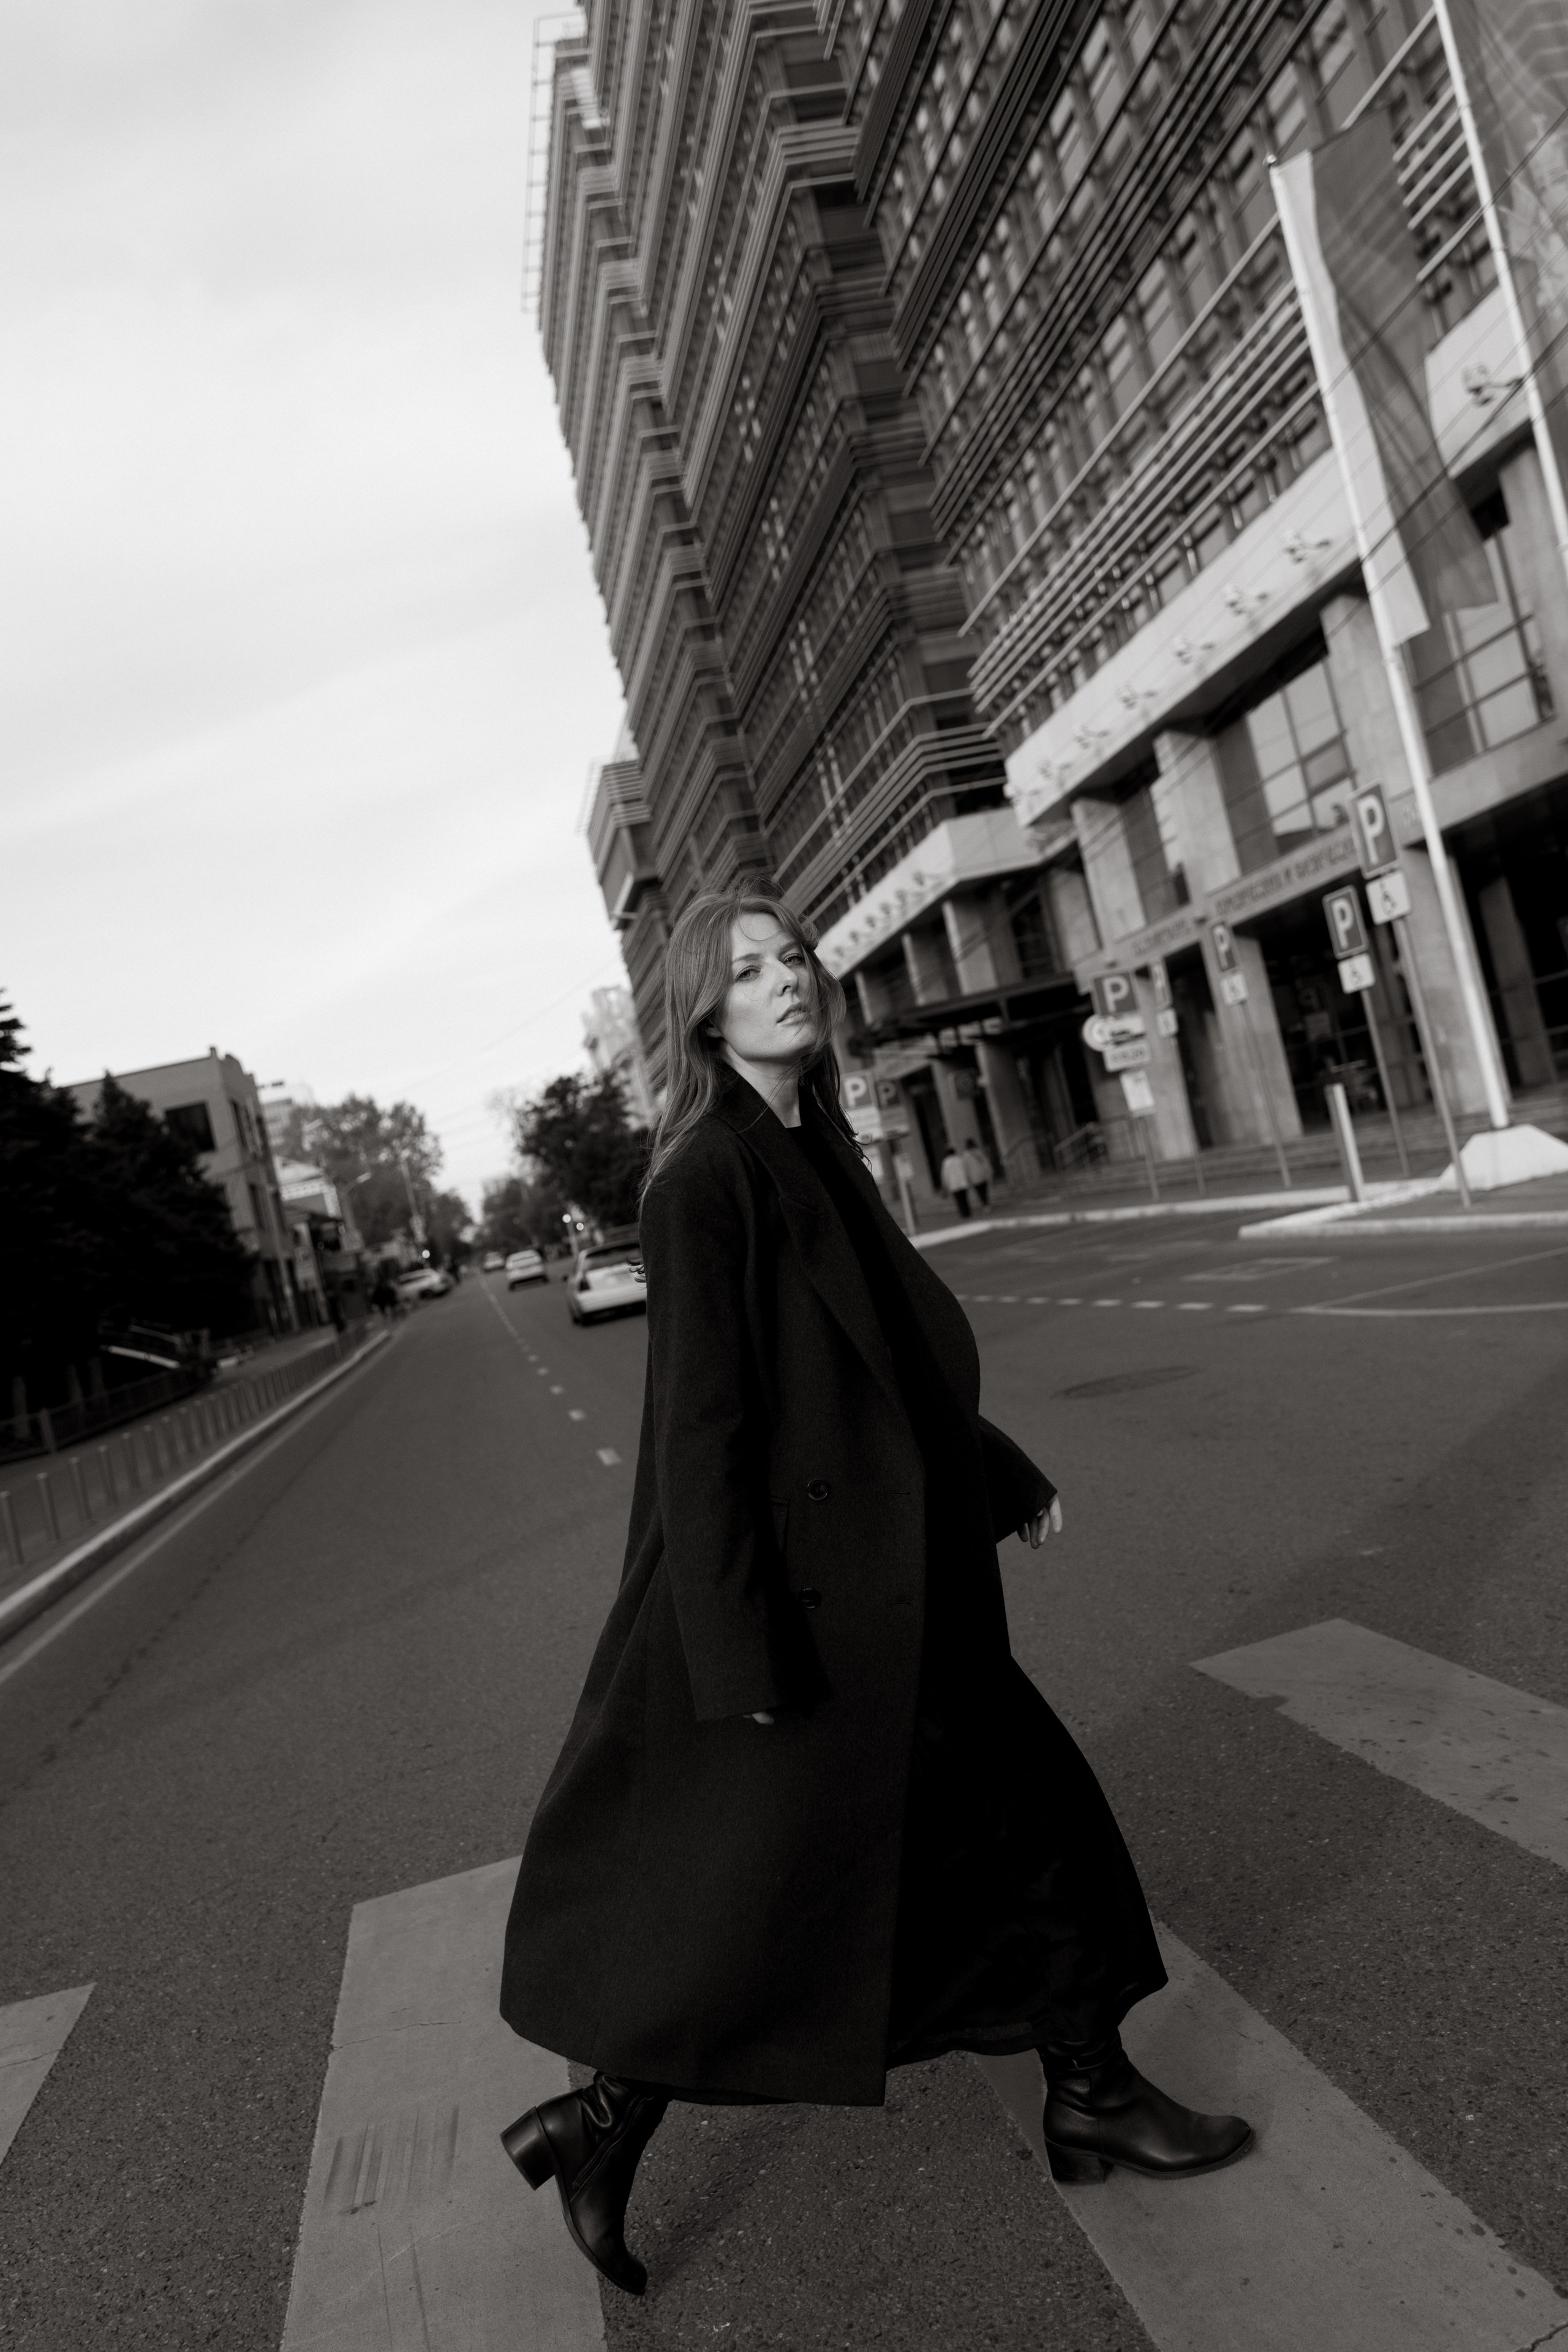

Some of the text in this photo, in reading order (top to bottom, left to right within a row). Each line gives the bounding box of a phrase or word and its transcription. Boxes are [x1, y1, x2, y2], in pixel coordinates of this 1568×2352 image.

[1356, 795, 1384, 865] P
[1330, 897, 1354, 949] P
[1213, 925, 1229, 969] P
[1103, 976, 1129, 1012] P
[843, 1076, 867, 1108] P
[876, 1080, 896, 1106] P
